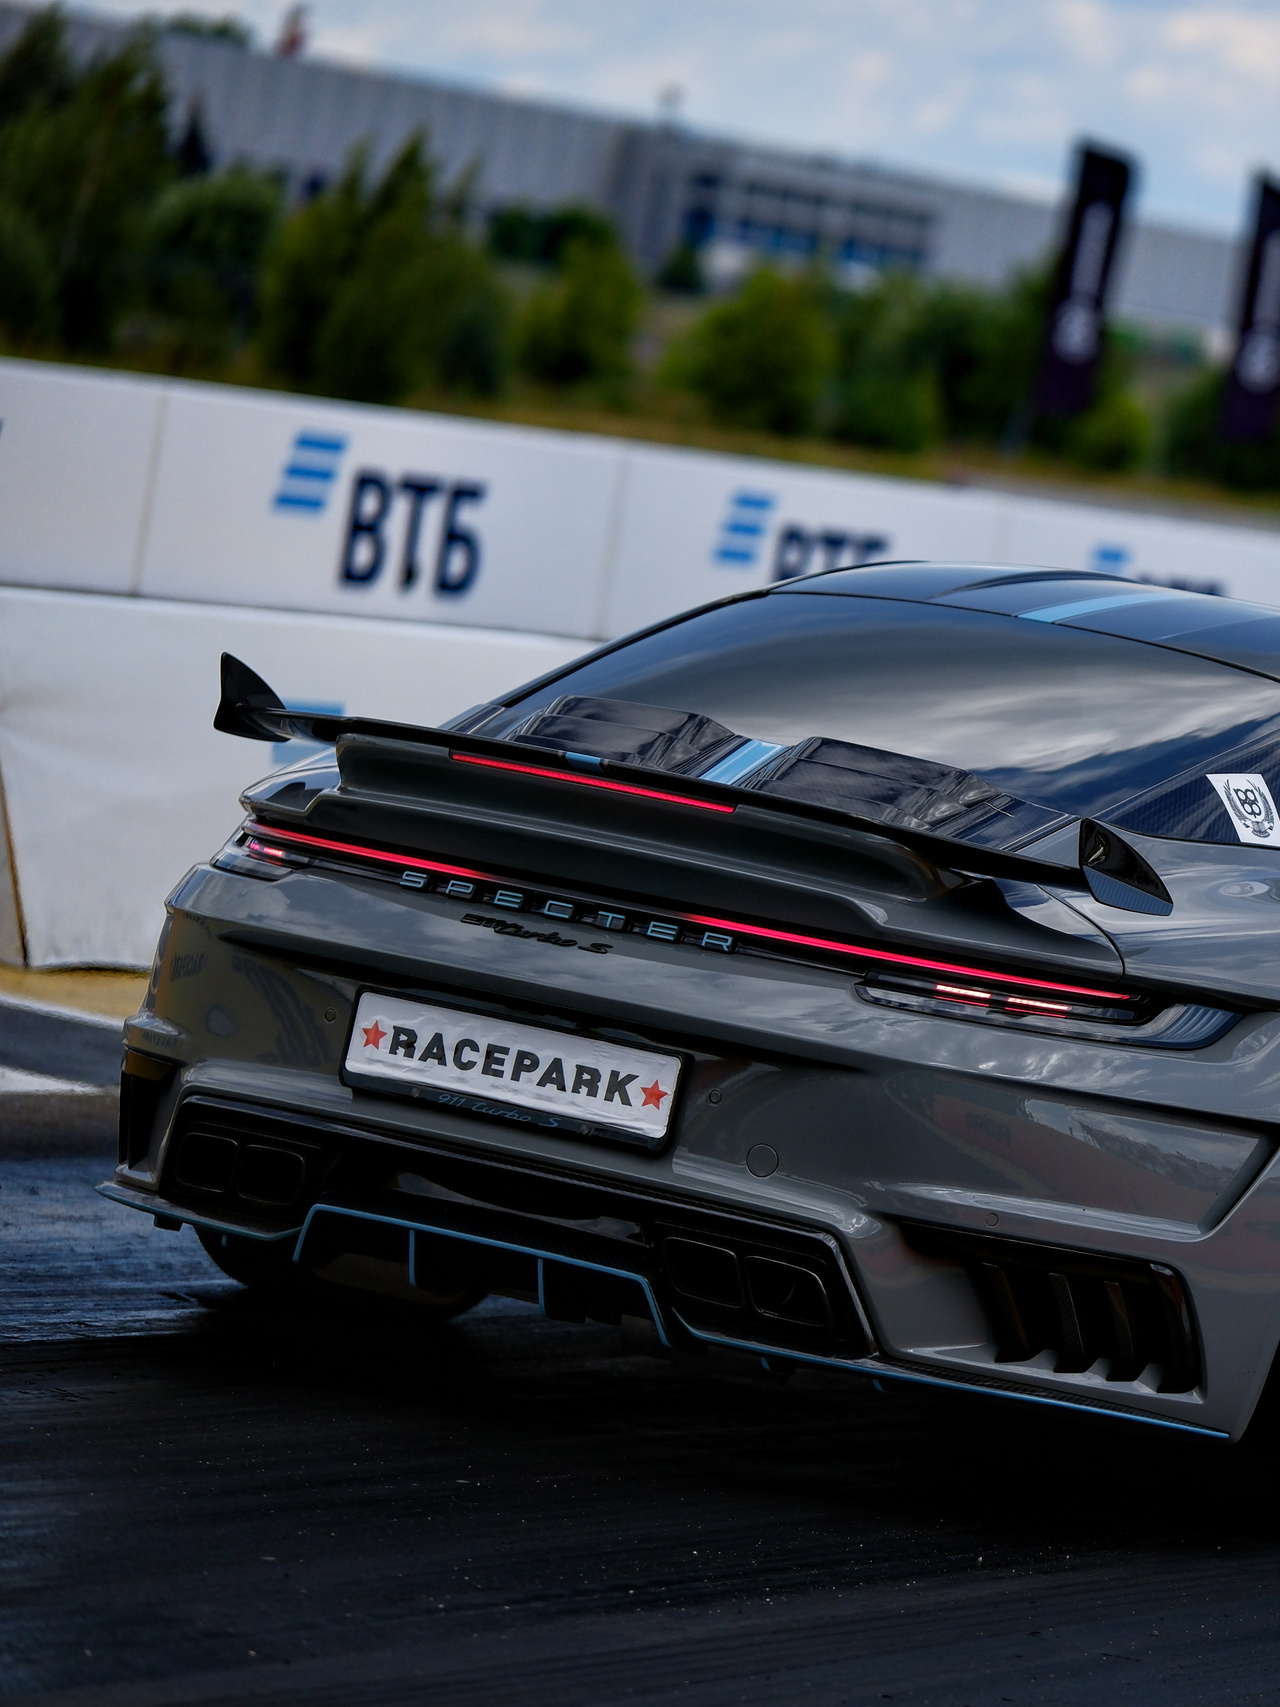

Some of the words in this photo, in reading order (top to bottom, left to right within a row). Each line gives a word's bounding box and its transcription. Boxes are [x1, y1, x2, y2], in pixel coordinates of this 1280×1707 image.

[337, 468, 486, 598] ВТБ
[399, 870, 733, 952] SPECTER
[388, 1025, 640, 1107] RACEPARK
[438, 1093, 467, 1107] 911
